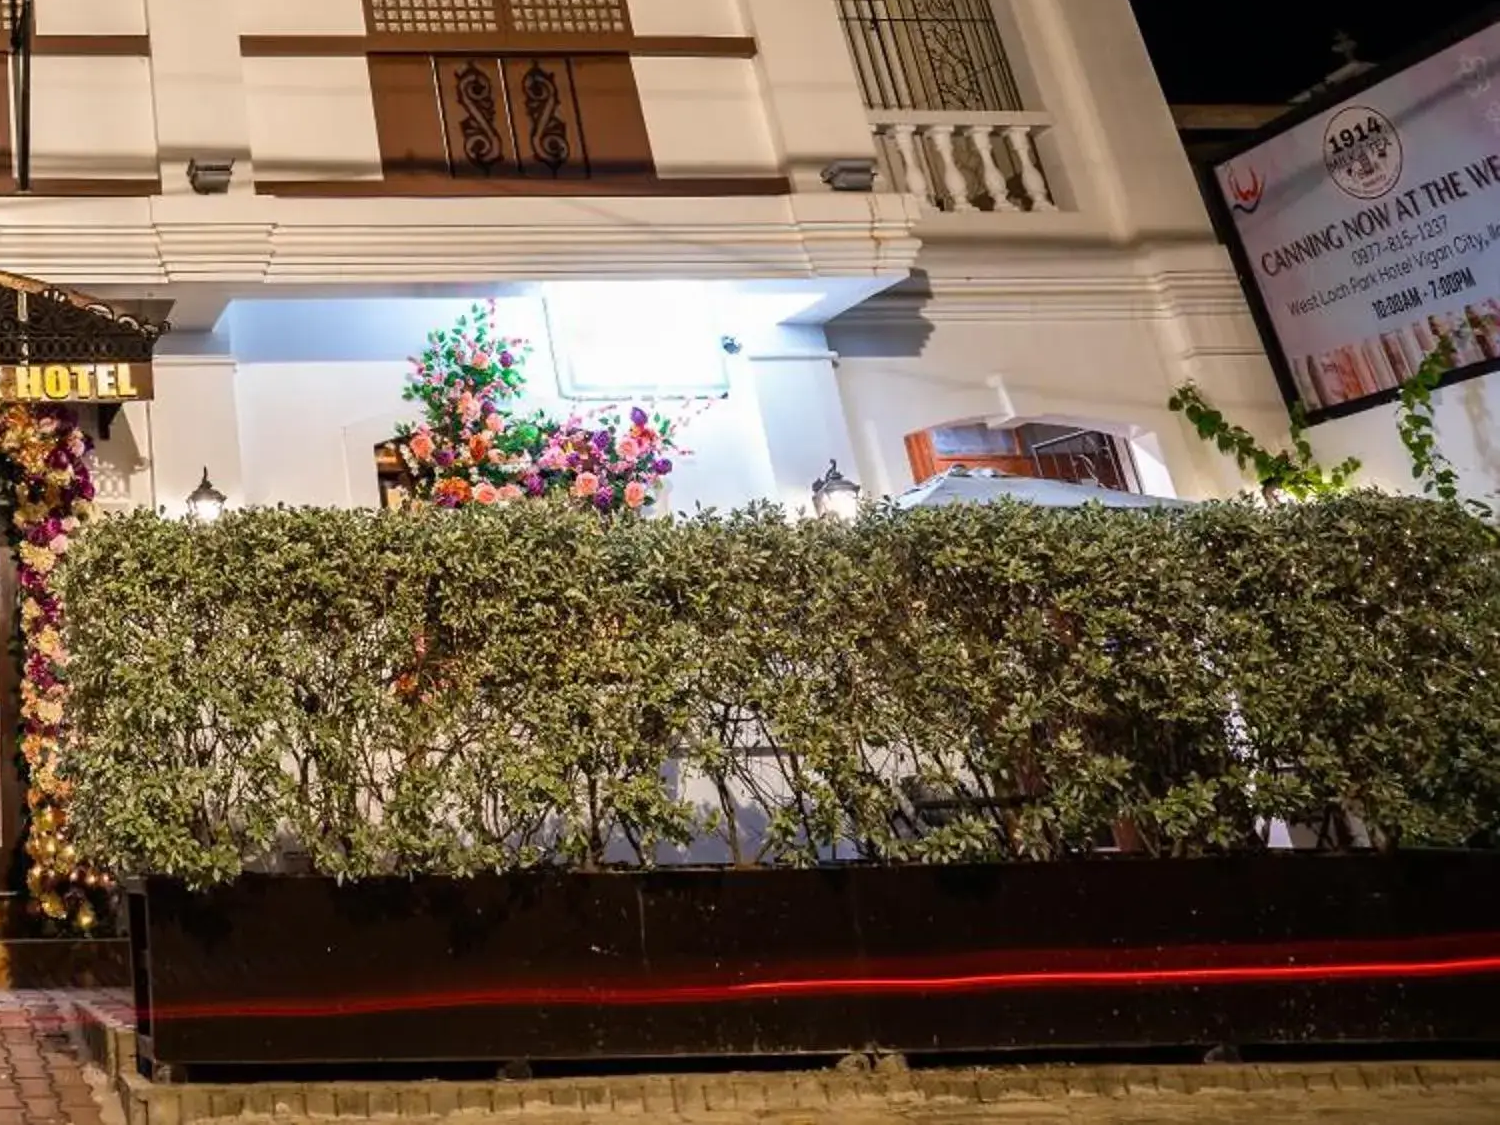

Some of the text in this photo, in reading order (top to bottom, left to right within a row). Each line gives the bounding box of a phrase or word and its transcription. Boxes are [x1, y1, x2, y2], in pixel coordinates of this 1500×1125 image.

[1329, 116, 1382, 154] 1914
[1262, 224, 1344, 276] CANNING
[1342, 202, 1392, 242] NOW
[1396, 189, 1421, 221] AT
[1420, 171, 1468, 208] THE
[1351, 214, 1447, 266] 0977-815-1237
[1287, 294, 1321, 316] West
[1318, 282, 1351, 306] Loch
[1349, 272, 1378, 294] Park
[1377, 256, 1413, 284] Hotel
[1411, 243, 1454, 271] Vigan
[1372, 286, 1423, 320] 10:00AM
[1428, 266, 1477, 300] 7:00PM
[15, 362, 137, 400] HOTEL
